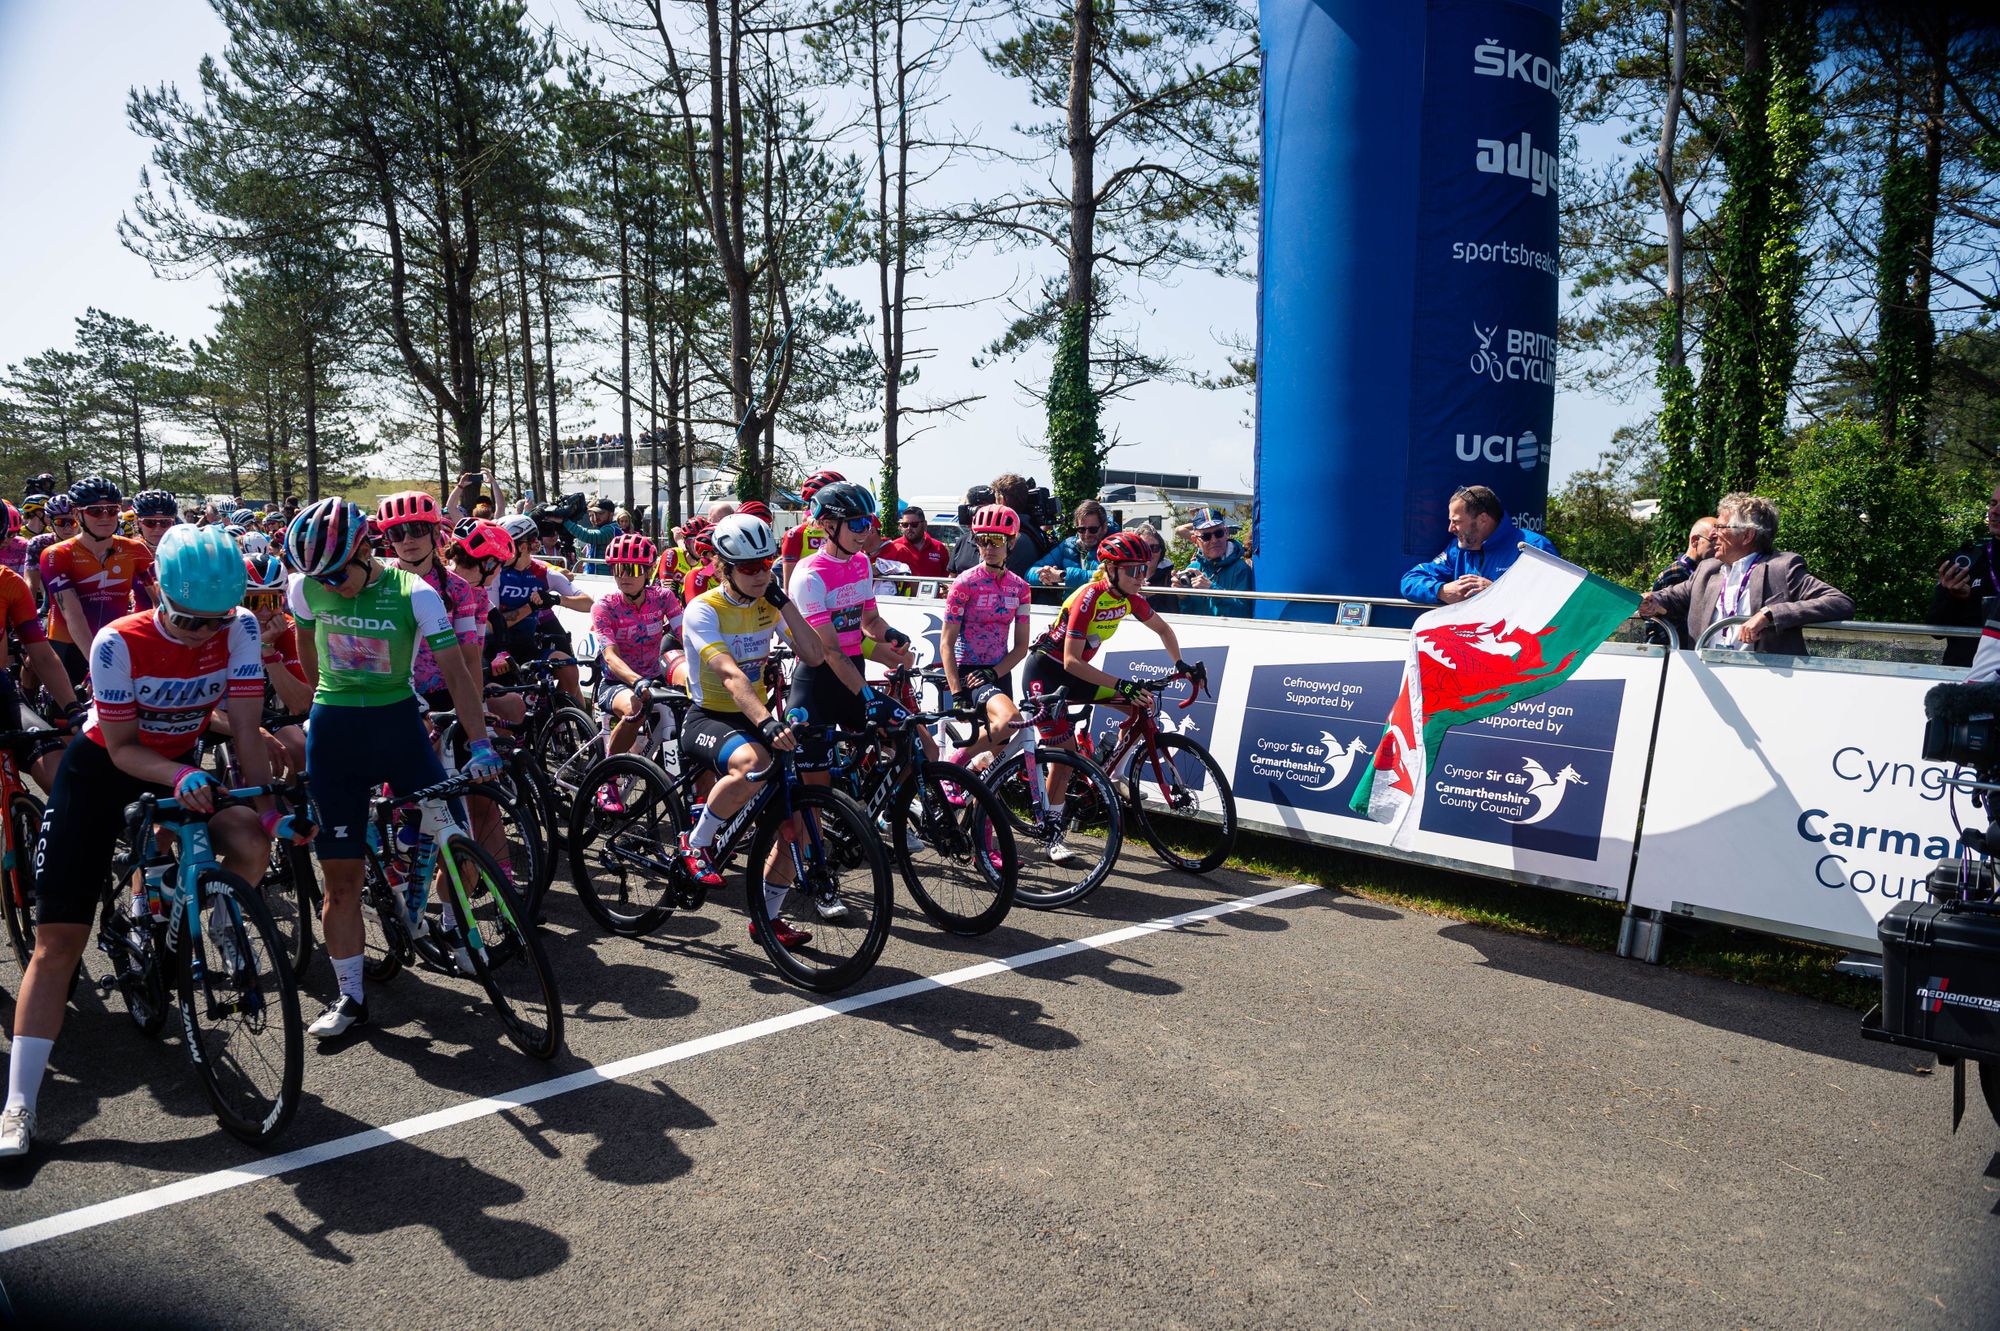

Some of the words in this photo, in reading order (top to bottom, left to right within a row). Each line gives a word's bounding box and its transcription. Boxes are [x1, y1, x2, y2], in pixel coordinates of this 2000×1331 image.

[1456, 434, 1513, 463] UCI
[501, 585, 530, 598] FDJ
[976, 593, 998, 607] EF
[1080, 587, 1096, 613] CAMS
[319, 611, 398, 631] ŠKODA
[1096, 606, 1127, 620] CAMS
[615, 625, 637, 639] EF
[1129, 661, 1175, 677] Cefnogwyd
[1175, 680, 1187, 692] by
[1283, 677, 1341, 694] Cefnogwyd
[1342, 684, 1363, 696] gan
[1285, 691, 1339, 708] Supported
[1340, 697, 1355, 711] by
[1505, 701, 1546, 716] gwyd
[1548, 706, 1574, 718] gan
[1546, 719, 1564, 735] by
[695, 732, 710, 747] FDJ
[1257, 737, 1289, 751] Cyngor
[1290, 742, 1304, 753] Sir
[1306, 744, 1324, 756] Gâr
[664, 749, 677, 767] 22
[1250, 754, 1326, 774] Carmarthenshire
[1253, 764, 1285, 780] County
[1286, 769, 1320, 784] Council
[1444, 763, 1484, 780] Cyngor
[1486, 769, 1502, 781] Sir
[1505, 772, 1528, 785] Gâr
[1435, 781, 1531, 805] Carmarthenshire
[1439, 794, 1478, 811] County
[1480, 800, 1523, 817] Council
[40, 808, 55, 833] LE
[35, 838, 47, 880] COL
[205, 880, 234, 898] MAVIC
